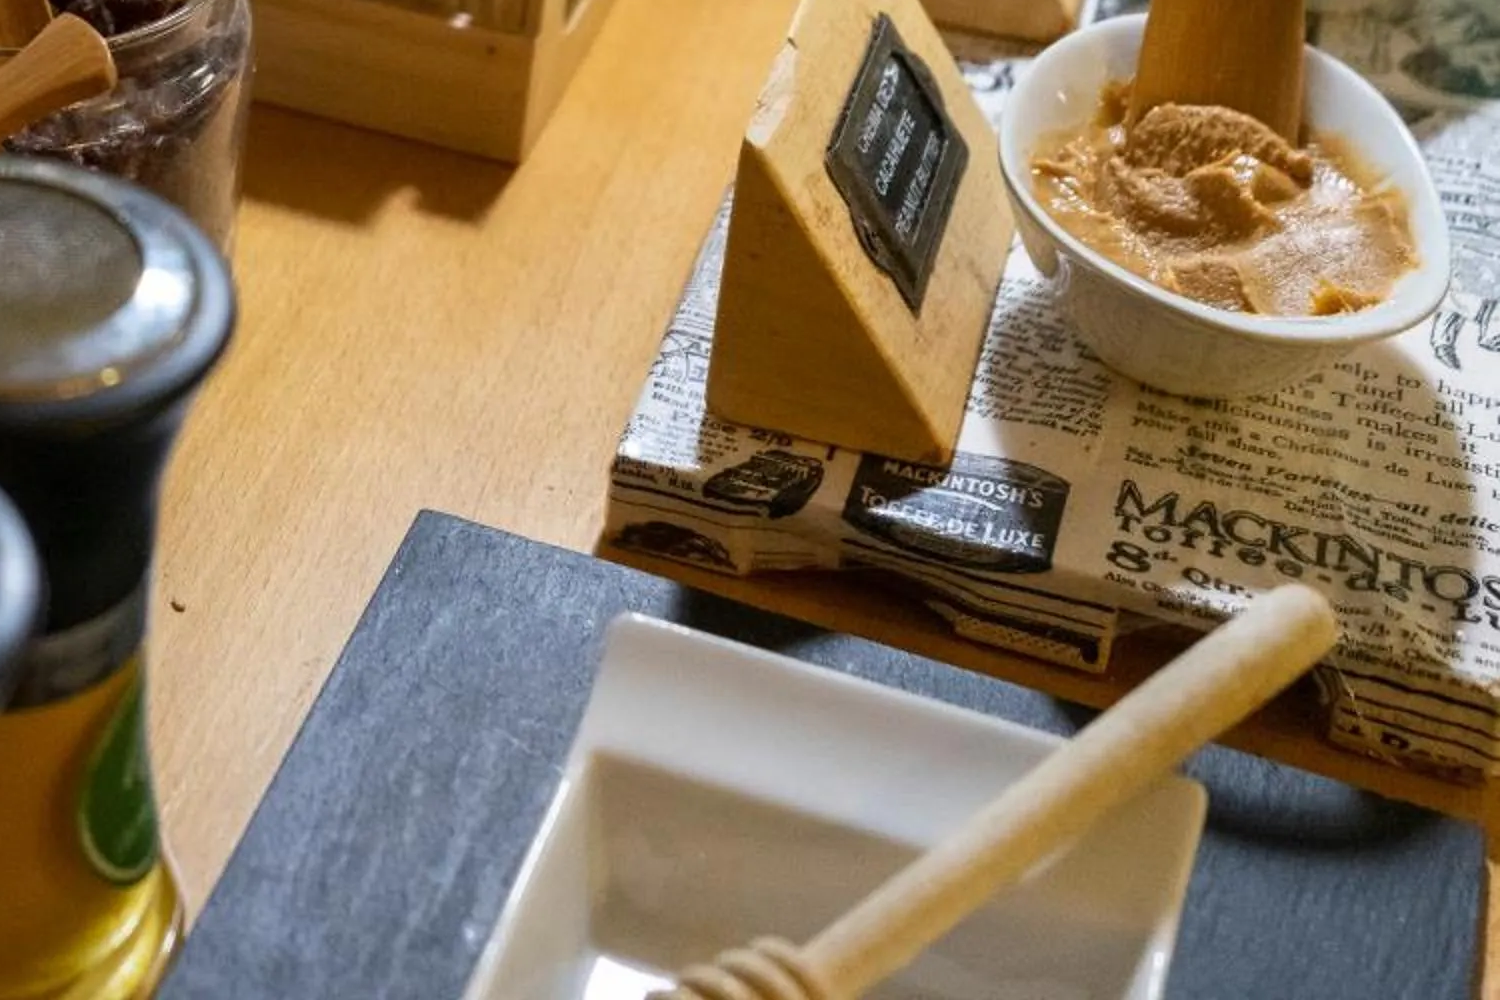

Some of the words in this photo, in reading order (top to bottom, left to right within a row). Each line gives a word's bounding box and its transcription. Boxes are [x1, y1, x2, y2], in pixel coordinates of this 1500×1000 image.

[1397, 373, 1421, 389] to
[1355, 383, 1403, 401] and
[1434, 400, 1464, 416] all
[1131, 414, 1176, 432] your
[1136, 400, 1191, 424] Make
[1204, 420, 1240, 434] this
[1271, 433, 1371, 469] Christmas
[1384, 462, 1410, 477] de
[1357, 416, 1439, 445] makes
[1460, 437, 1477, 454] it
[1367, 431, 1387, 451] is
[883, 459, 1045, 509] MACKINTOSH'S
